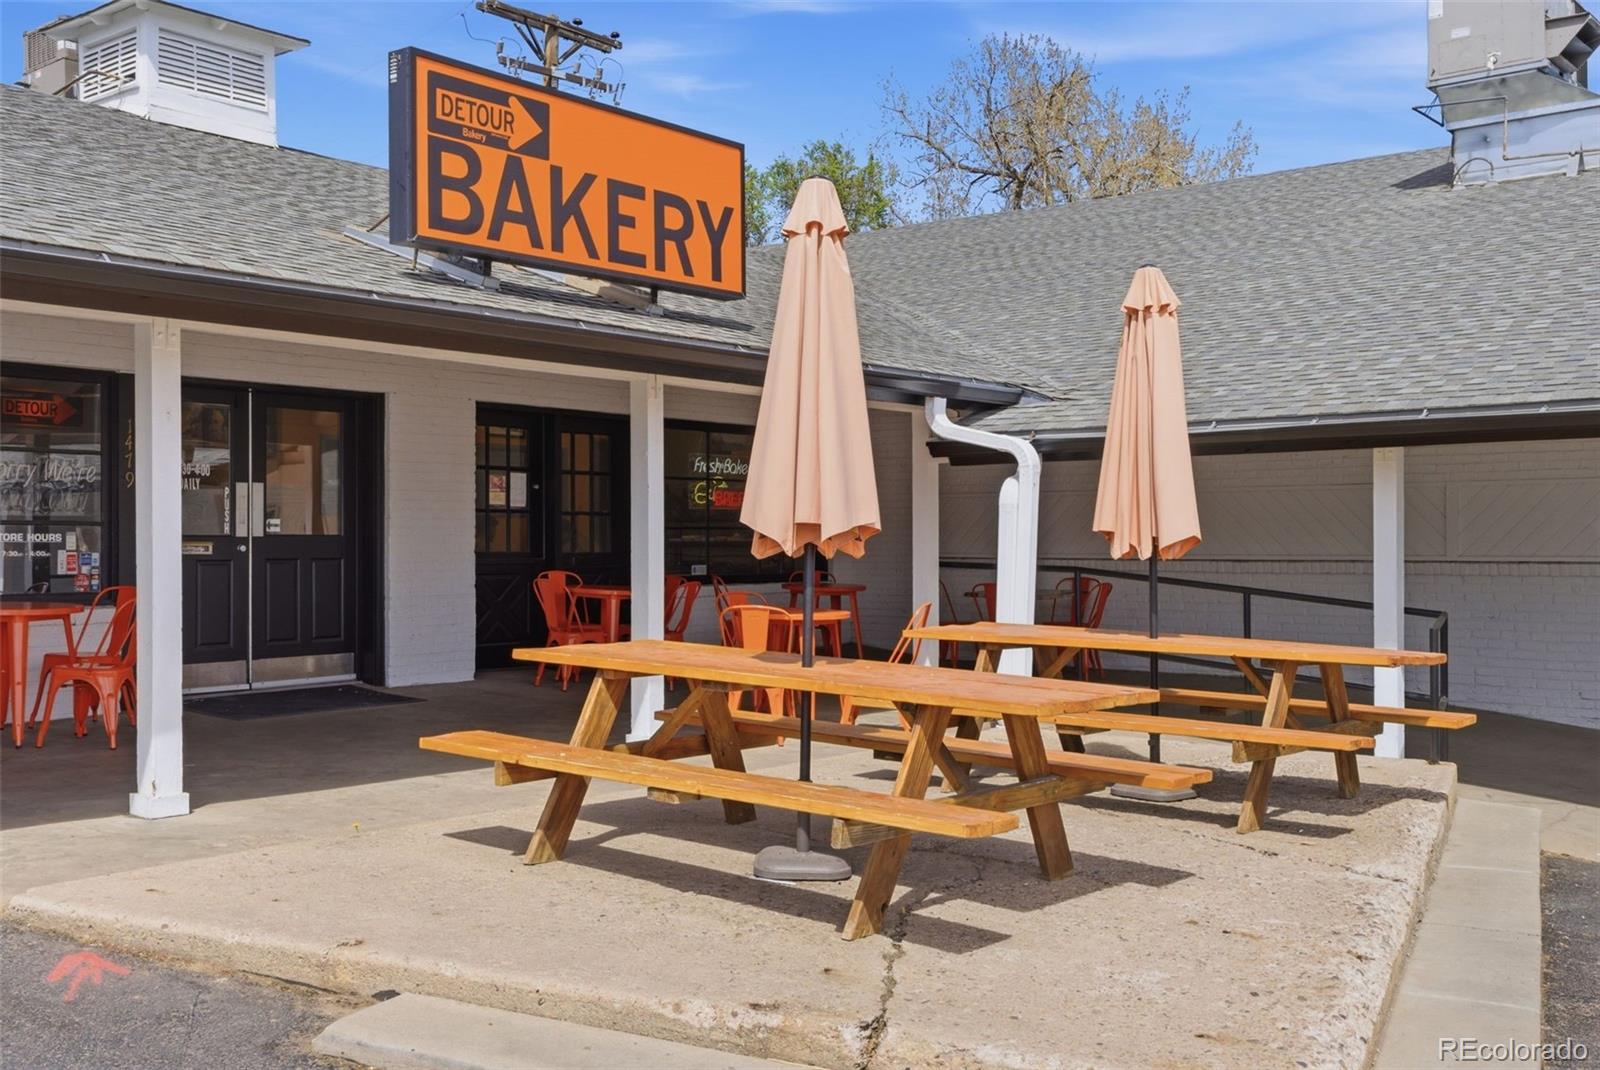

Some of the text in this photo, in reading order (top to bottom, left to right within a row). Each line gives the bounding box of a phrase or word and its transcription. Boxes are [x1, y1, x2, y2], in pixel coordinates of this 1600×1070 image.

[441, 93, 515, 134] DETOUR
[462, 127, 487, 143] Bakery
[428, 134, 734, 282] BAKERY
[5, 400, 58, 416] DETOUR
[723, 458, 750, 475] Bake
[0, 463, 36, 487] orry
[182, 478, 200, 490] AILY
[0, 533, 23, 542] TORE
[27, 533, 63, 543] HOURS
